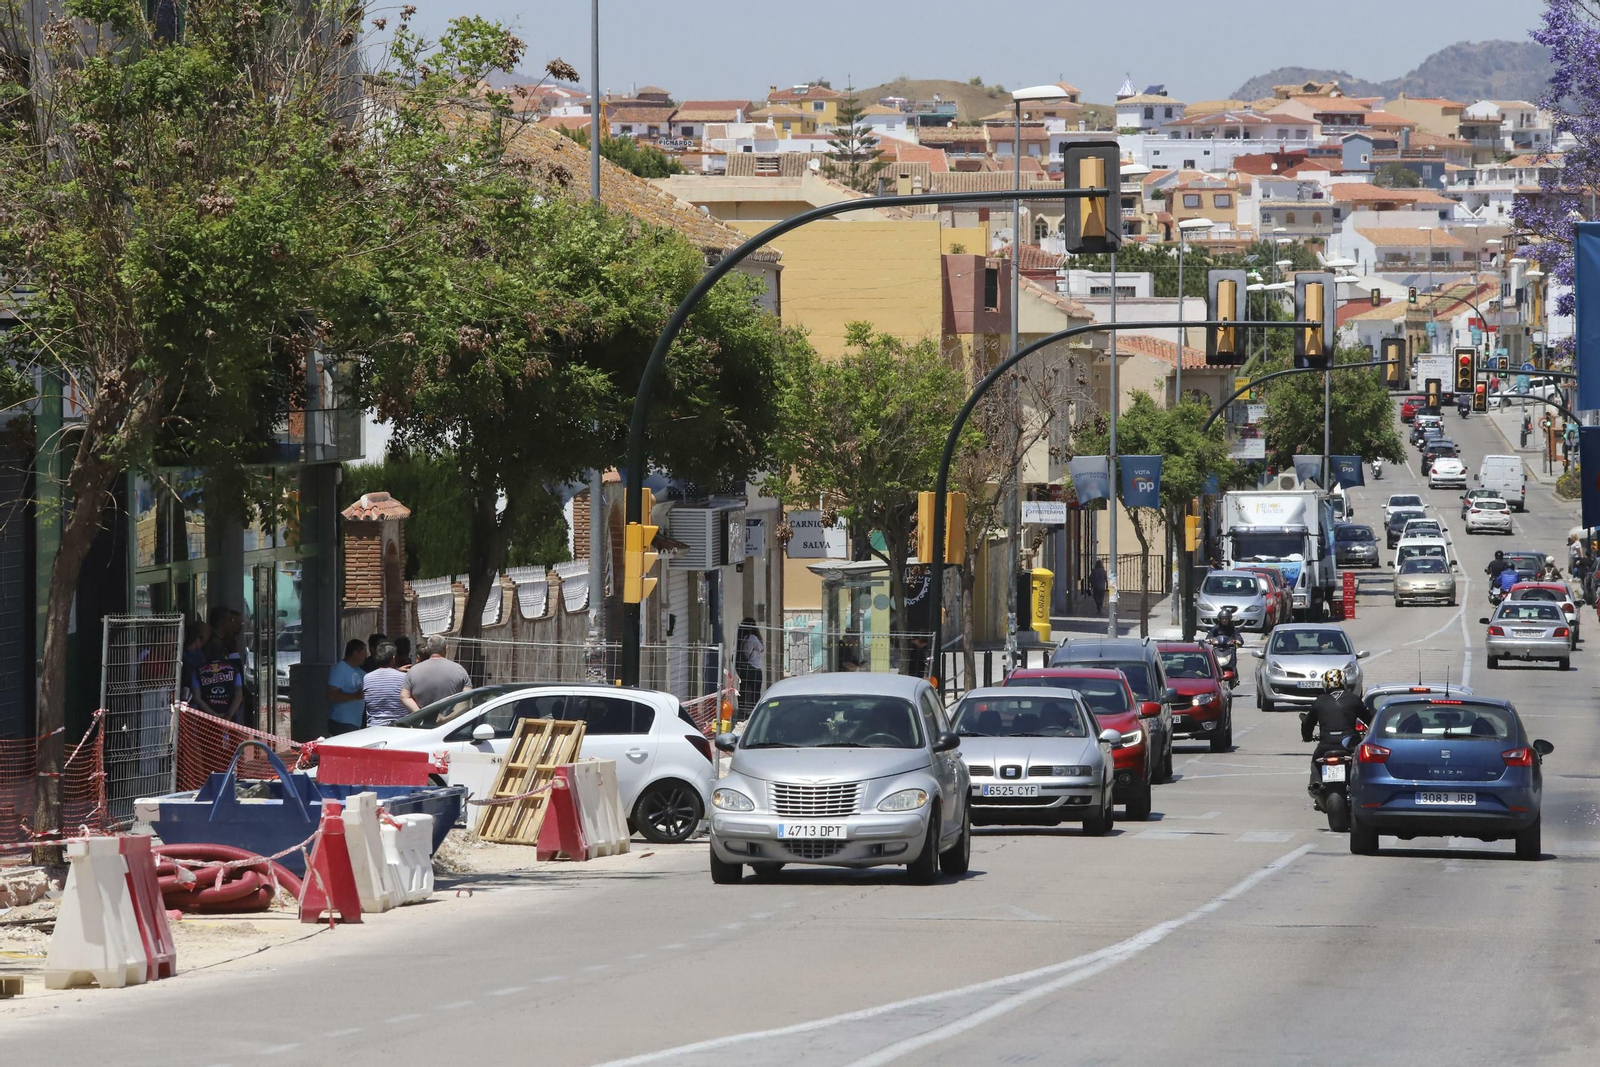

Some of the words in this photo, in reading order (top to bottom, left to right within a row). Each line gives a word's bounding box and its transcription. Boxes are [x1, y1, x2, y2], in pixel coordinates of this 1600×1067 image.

[803, 541, 831, 549] SALVA
[989, 786, 1014, 796] 6525
[1017, 786, 1036, 796] CYF
[1422, 793, 1449, 803] 3083
[1454, 794, 1474, 804] JRB
[788, 825, 817, 837] 4713
[820, 825, 842, 837] DPT
